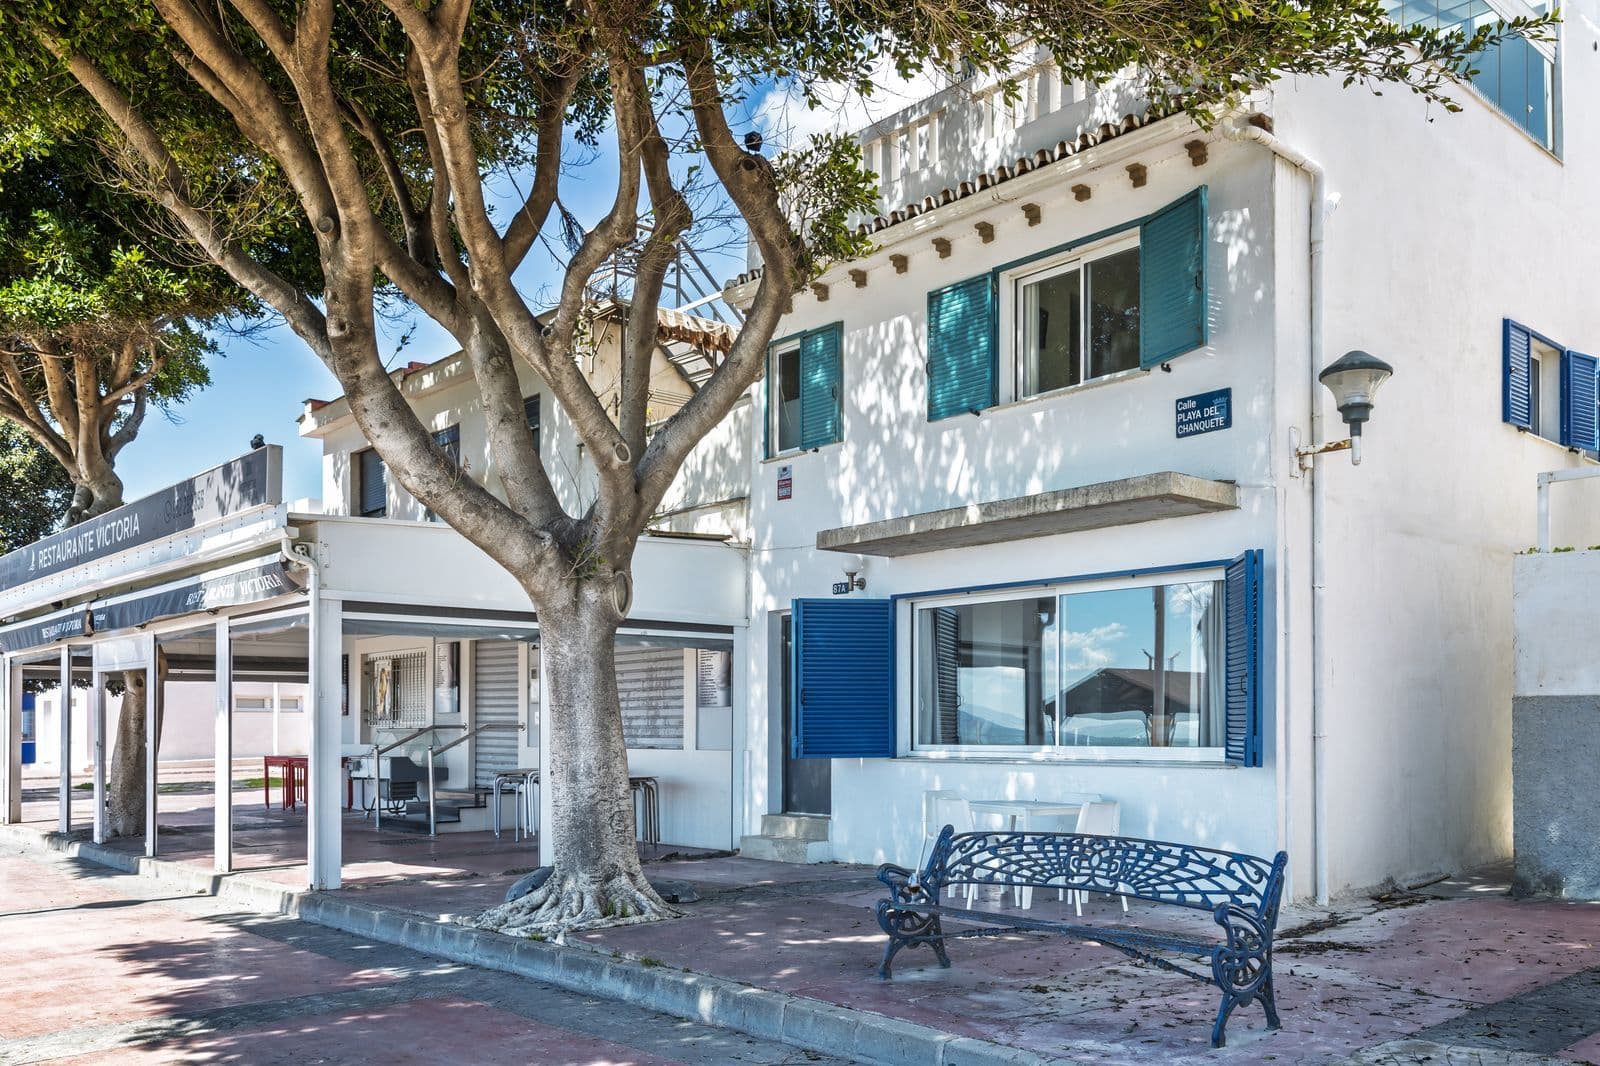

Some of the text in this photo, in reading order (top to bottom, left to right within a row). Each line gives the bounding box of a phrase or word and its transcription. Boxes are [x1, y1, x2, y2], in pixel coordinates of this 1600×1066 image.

[1177, 400, 1196, 411] Calle
[1177, 406, 1219, 422] PLAYA DEL
[1177, 417, 1224, 434] CHANQUETE
[38, 513, 139, 570] RESTAURANTE VICTORIA
[240, 573, 283, 595] VICTORIA
